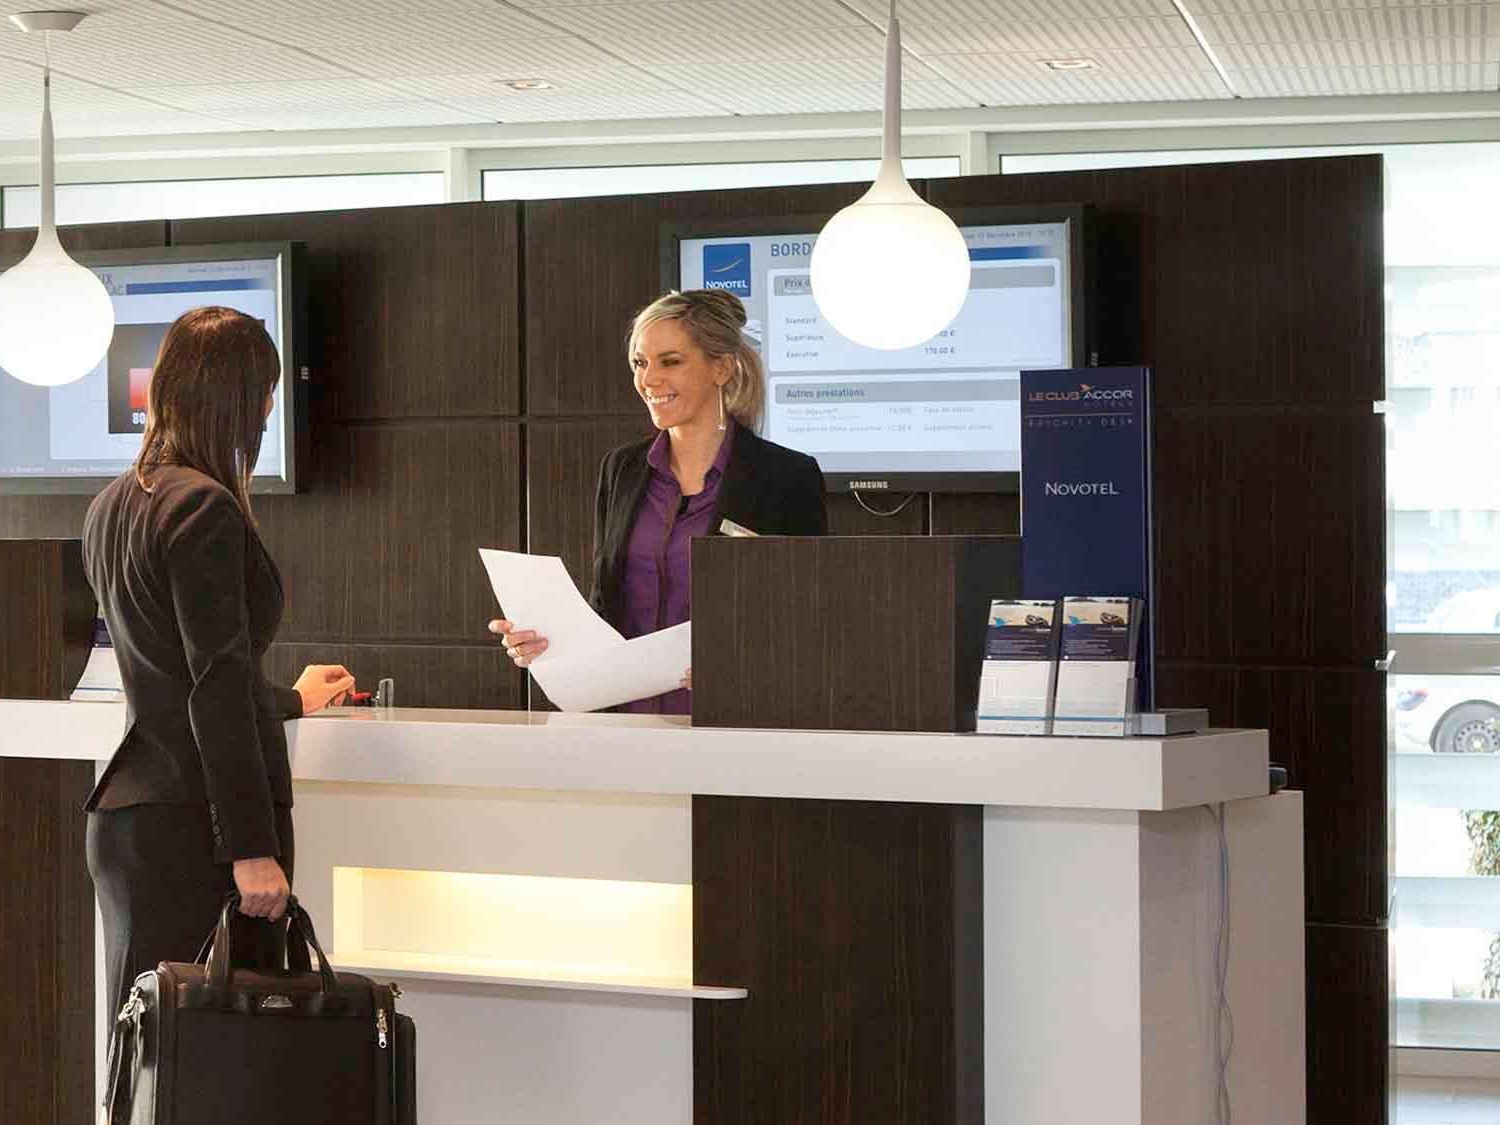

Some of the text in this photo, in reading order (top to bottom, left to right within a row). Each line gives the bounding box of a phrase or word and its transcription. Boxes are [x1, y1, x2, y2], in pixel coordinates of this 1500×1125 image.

[705, 280, 749, 289] NOVOTEL
[816, 387, 865, 399] prestations
[1083, 389, 1133, 401] ACCOR
[850, 480, 889, 489] SAMSUNG
[1044, 481, 1120, 496] NOVOTEL
